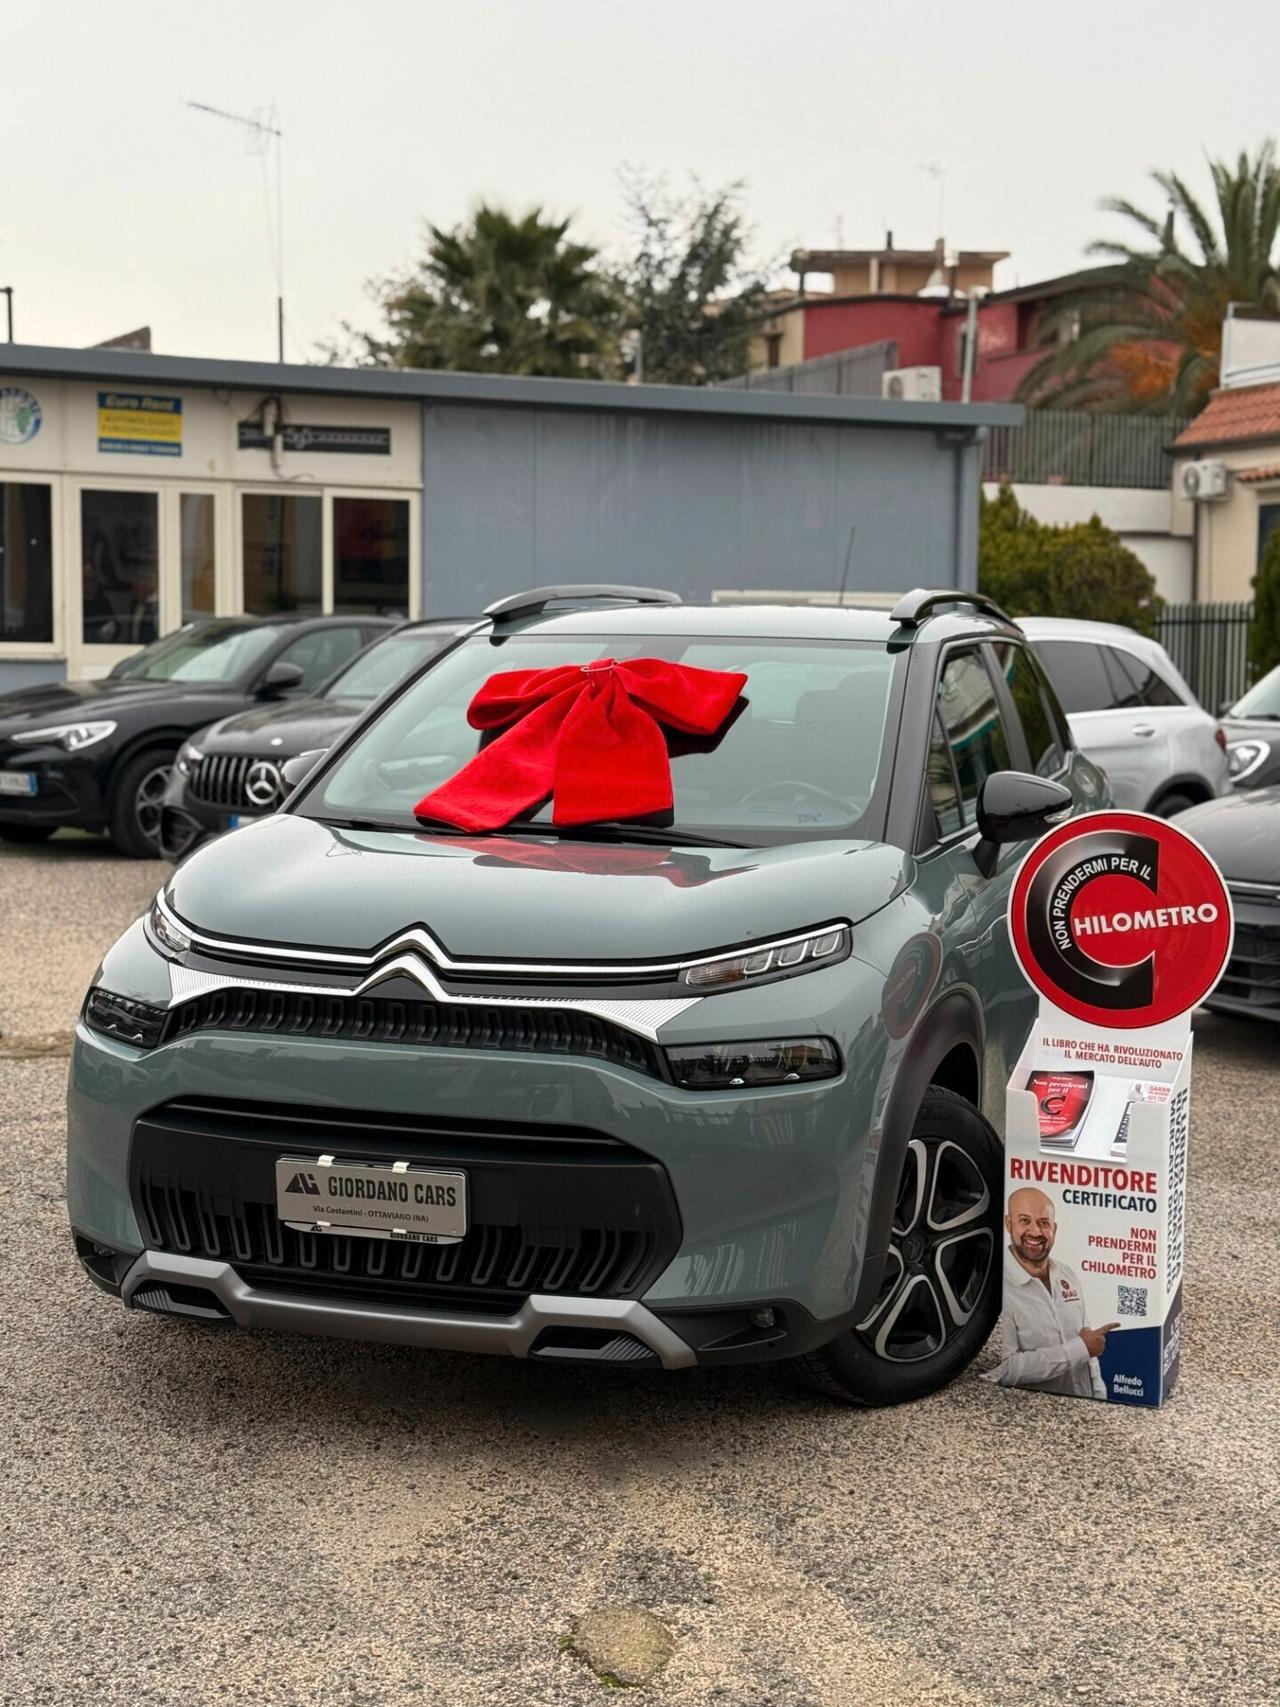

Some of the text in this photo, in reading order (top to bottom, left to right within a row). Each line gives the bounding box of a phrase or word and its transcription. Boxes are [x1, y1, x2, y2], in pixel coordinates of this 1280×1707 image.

[1053, 857, 1152, 950] NON PRENDERMI PER IL
[1043, 1038, 1183, 1061] IL LIBRO CHE HA RIVOLUZIONATO
[1064, 1051, 1162, 1069] IL MERCATO DELL'AUTO
[1010, 1158, 1157, 1194] RIVENDITORE
[328, 1176, 408, 1203] GIORDANO
[414, 1184, 456, 1207] CARS
[1062, 1189, 1157, 1213] CERTIFICATO
[313, 1205, 324, 1214] Via
[326, 1206, 363, 1217] Costantini
[368, 1210, 412, 1221] OTTAVIANO
[413, 1214, 429, 1223] (NA)
[422, 1234, 438, 1243] CARS
[1131, 1228, 1157, 1241] NON
[1088, 1235, 1157, 1254] PRENDERMI
[1122, 1252, 1157, 1267] PER IL
[1081, 1260, 1156, 1280] CHILOMETRO
[1113, 1374, 1142, 1387] Alfredo
[1113, 1384, 1144, 1397] Bellucci
